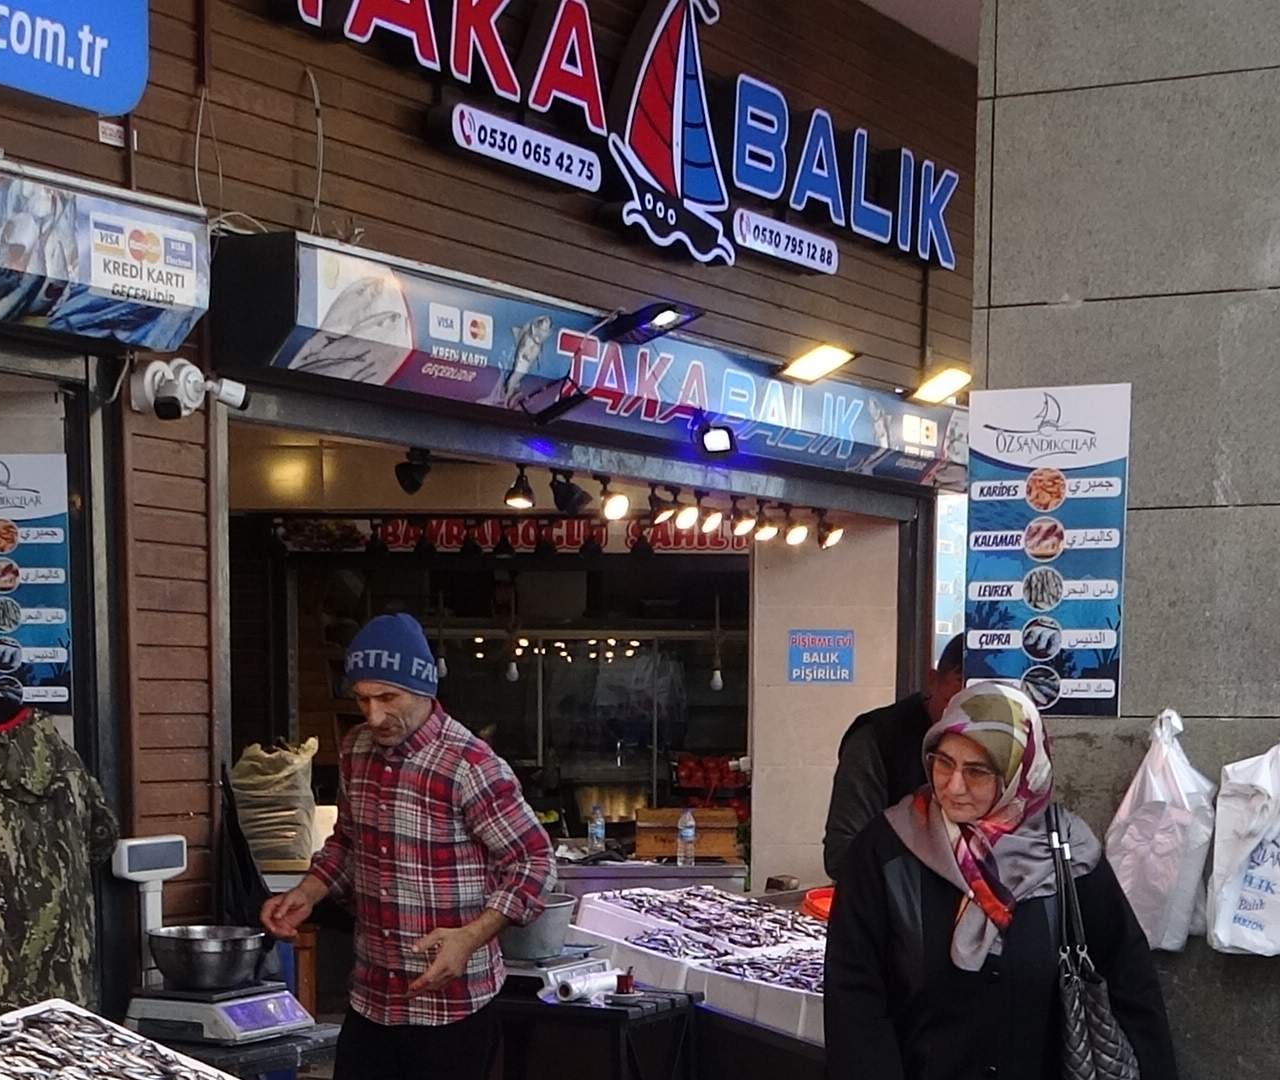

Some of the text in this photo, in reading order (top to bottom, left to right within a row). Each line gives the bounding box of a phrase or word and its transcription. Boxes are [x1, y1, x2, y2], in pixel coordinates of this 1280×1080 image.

[297, 0, 609, 137] AKA
[478, 124, 594, 181] 0530 065 42 75
[732, 73, 960, 271] BALIK
[100, 231, 120, 246] VISA
[753, 224, 833, 266] 0530 795 12 88
[147, 267, 185, 288] KARTI
[556, 329, 864, 459] TAKA BALIK
[979, 481, 1019, 497] KARİDES
[973, 533, 1022, 548] KALAMAR
[978, 584, 1014, 598] LEVREK
[978, 633, 1012, 648] ÇUPRA
[802, 652, 839, 663] BALIK
[792, 666, 849, 682] PİŞİRİLİR
